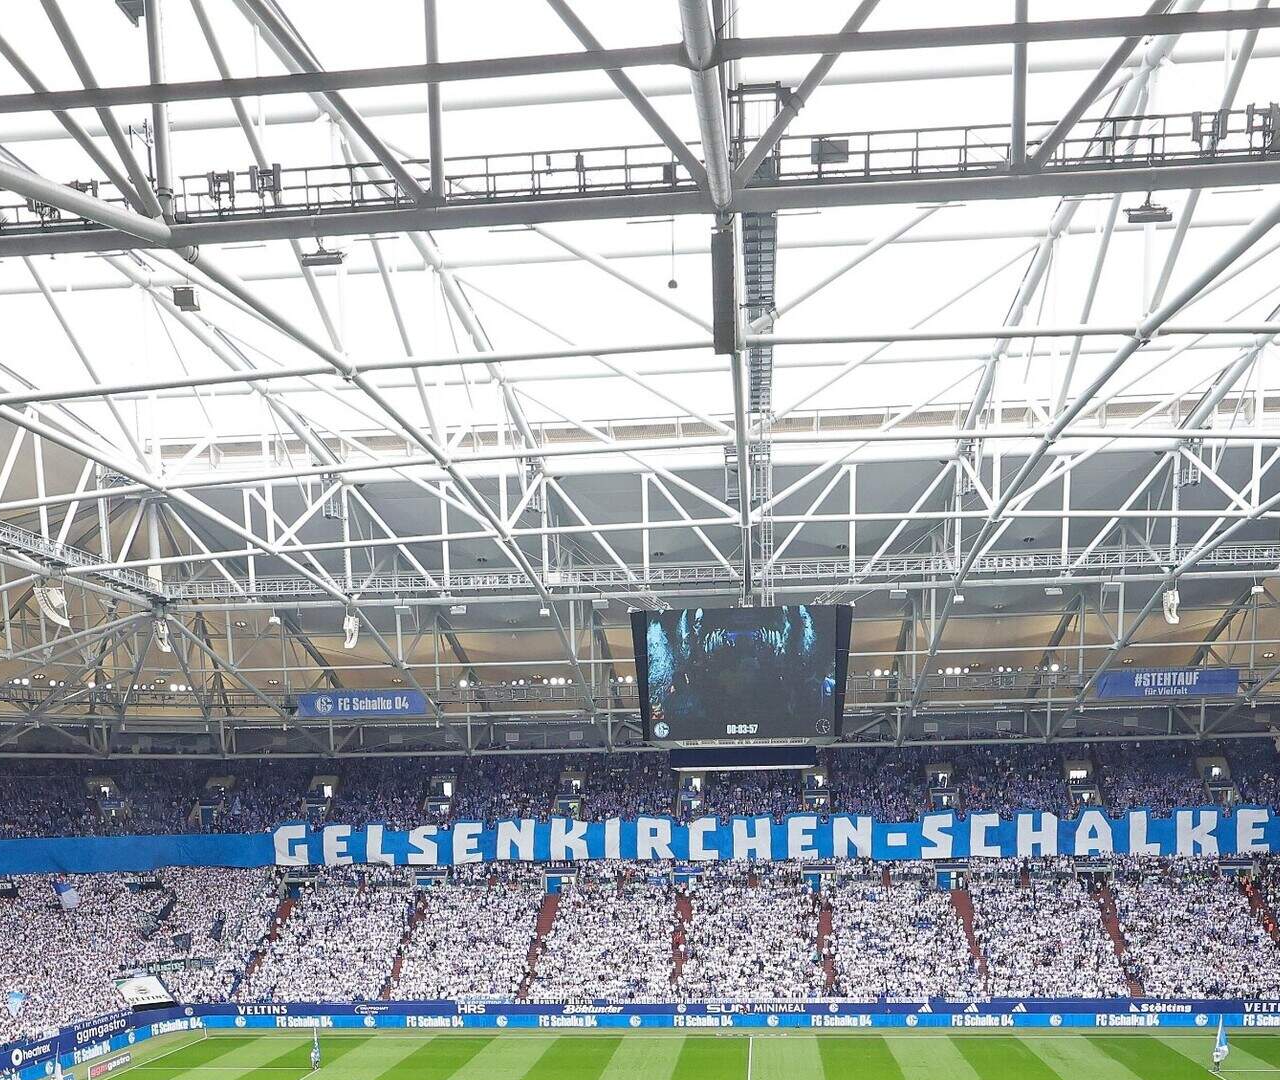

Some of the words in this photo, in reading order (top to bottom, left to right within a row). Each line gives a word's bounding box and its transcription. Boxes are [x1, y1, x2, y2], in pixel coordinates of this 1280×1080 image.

[1134, 672, 1199, 687] #STEHTAUF
[1144, 687, 1157, 696] für
[1158, 686, 1188, 695] Vielfalt
[337, 698, 350, 711] FC
[352, 697, 393, 711] Schalke
[394, 698, 409, 710] 04
[726, 724, 758, 734] 00:03:57
[273, 808, 1269, 865] GELSENKIRCHEN-SCHALKE
[237, 1004, 288, 1015] VELTINS
[457, 1004, 486, 1014] HRS
[563, 1004, 624, 1014] Böklunder
[755, 1003, 806, 1013] MINIMEAL
[1140, 1002, 1192, 1013] Stölting
[276, 1016, 287, 1027] FC
[288, 1015, 320, 1027] Schalke
[321, 1016, 333, 1027] 04
[406, 1016, 417, 1027] FC
[418, 1015, 452, 1027] Schalke
[453, 1016, 464, 1027] 04
[539, 1015, 550, 1027] FC
[551, 1015, 585, 1027] Schalke
[586, 1015, 598, 1027] 04
[673, 1015, 685, 1026] FC
[686, 1015, 720, 1026] Schalke
[721, 1015, 733, 1026] 04
[811, 1015, 822, 1026] FC
[823, 1015, 859, 1026] Schalke
[860, 1015, 872, 1026] 04
[951, 1015, 963, 1026] FC
[965, 1014, 1000, 1026] Schalke
[1001, 1015, 1014, 1026] 04
[1096, 1015, 1108, 1026] FC
[1109, 1014, 1145, 1026] Schalke
[1146, 1015, 1159, 1026] 04
[1243, 1014, 1255, 1026] FC
[76, 1018, 126, 1043] ggmgastro
[22, 1043, 51, 1060] heatrex
[89, 1054, 131, 1078] ggmgastro
